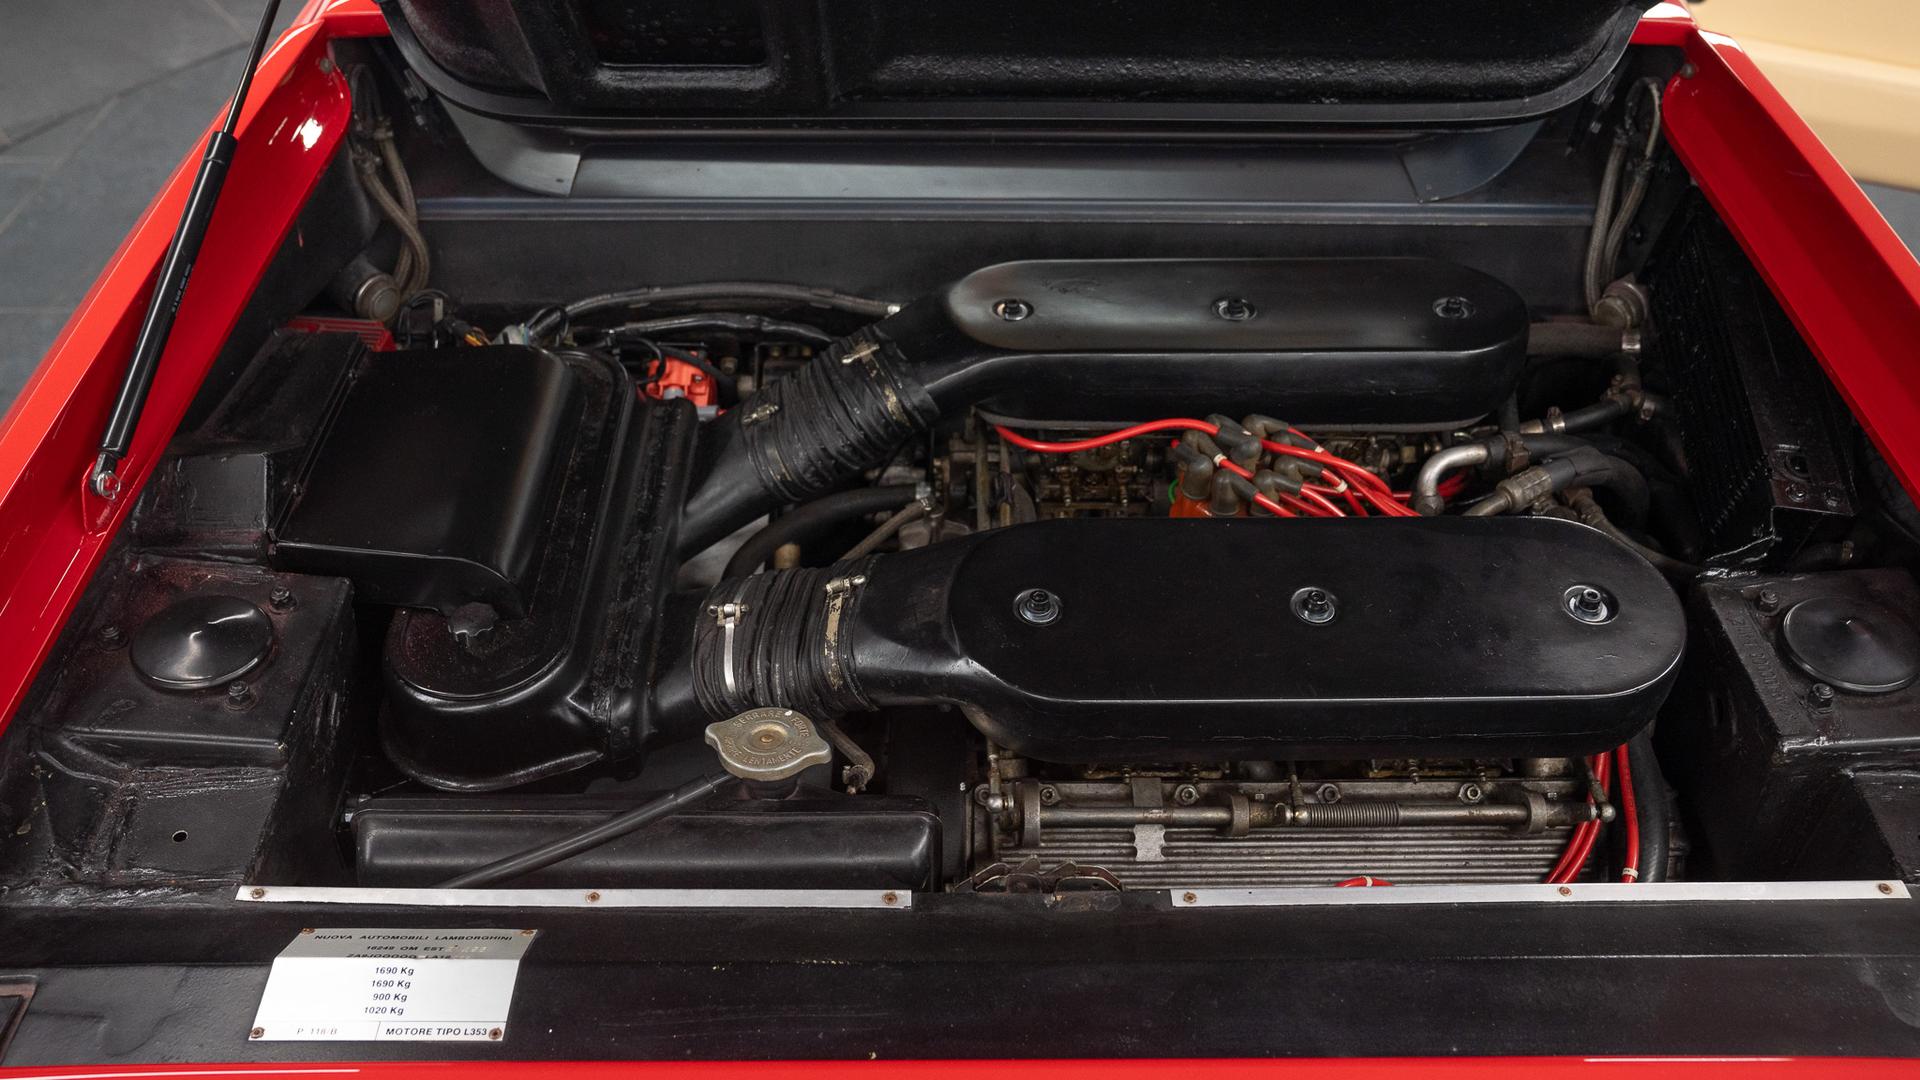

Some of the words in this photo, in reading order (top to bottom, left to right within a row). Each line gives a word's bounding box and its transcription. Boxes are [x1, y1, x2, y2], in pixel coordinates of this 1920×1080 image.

[733, 710, 784, 728] SERRARE
[790, 717, 811, 738] FORTE
[743, 747, 802, 766] LENTAMENTE
[375, 966, 398, 975] 1690
[400, 966, 415, 977] Kg
[371, 979, 395, 988] 1690
[397, 979, 412, 989] Kg
[372, 993, 391, 1001] 900
[393, 993, 408, 1003] Kg
[364, 1006, 388, 1014] 1020
[390, 1006, 405, 1016] Kg
[385, 1027, 433, 1036] MOTORE
[436, 1027, 460, 1036] TIPO
[464, 1027, 487, 1036] L353
